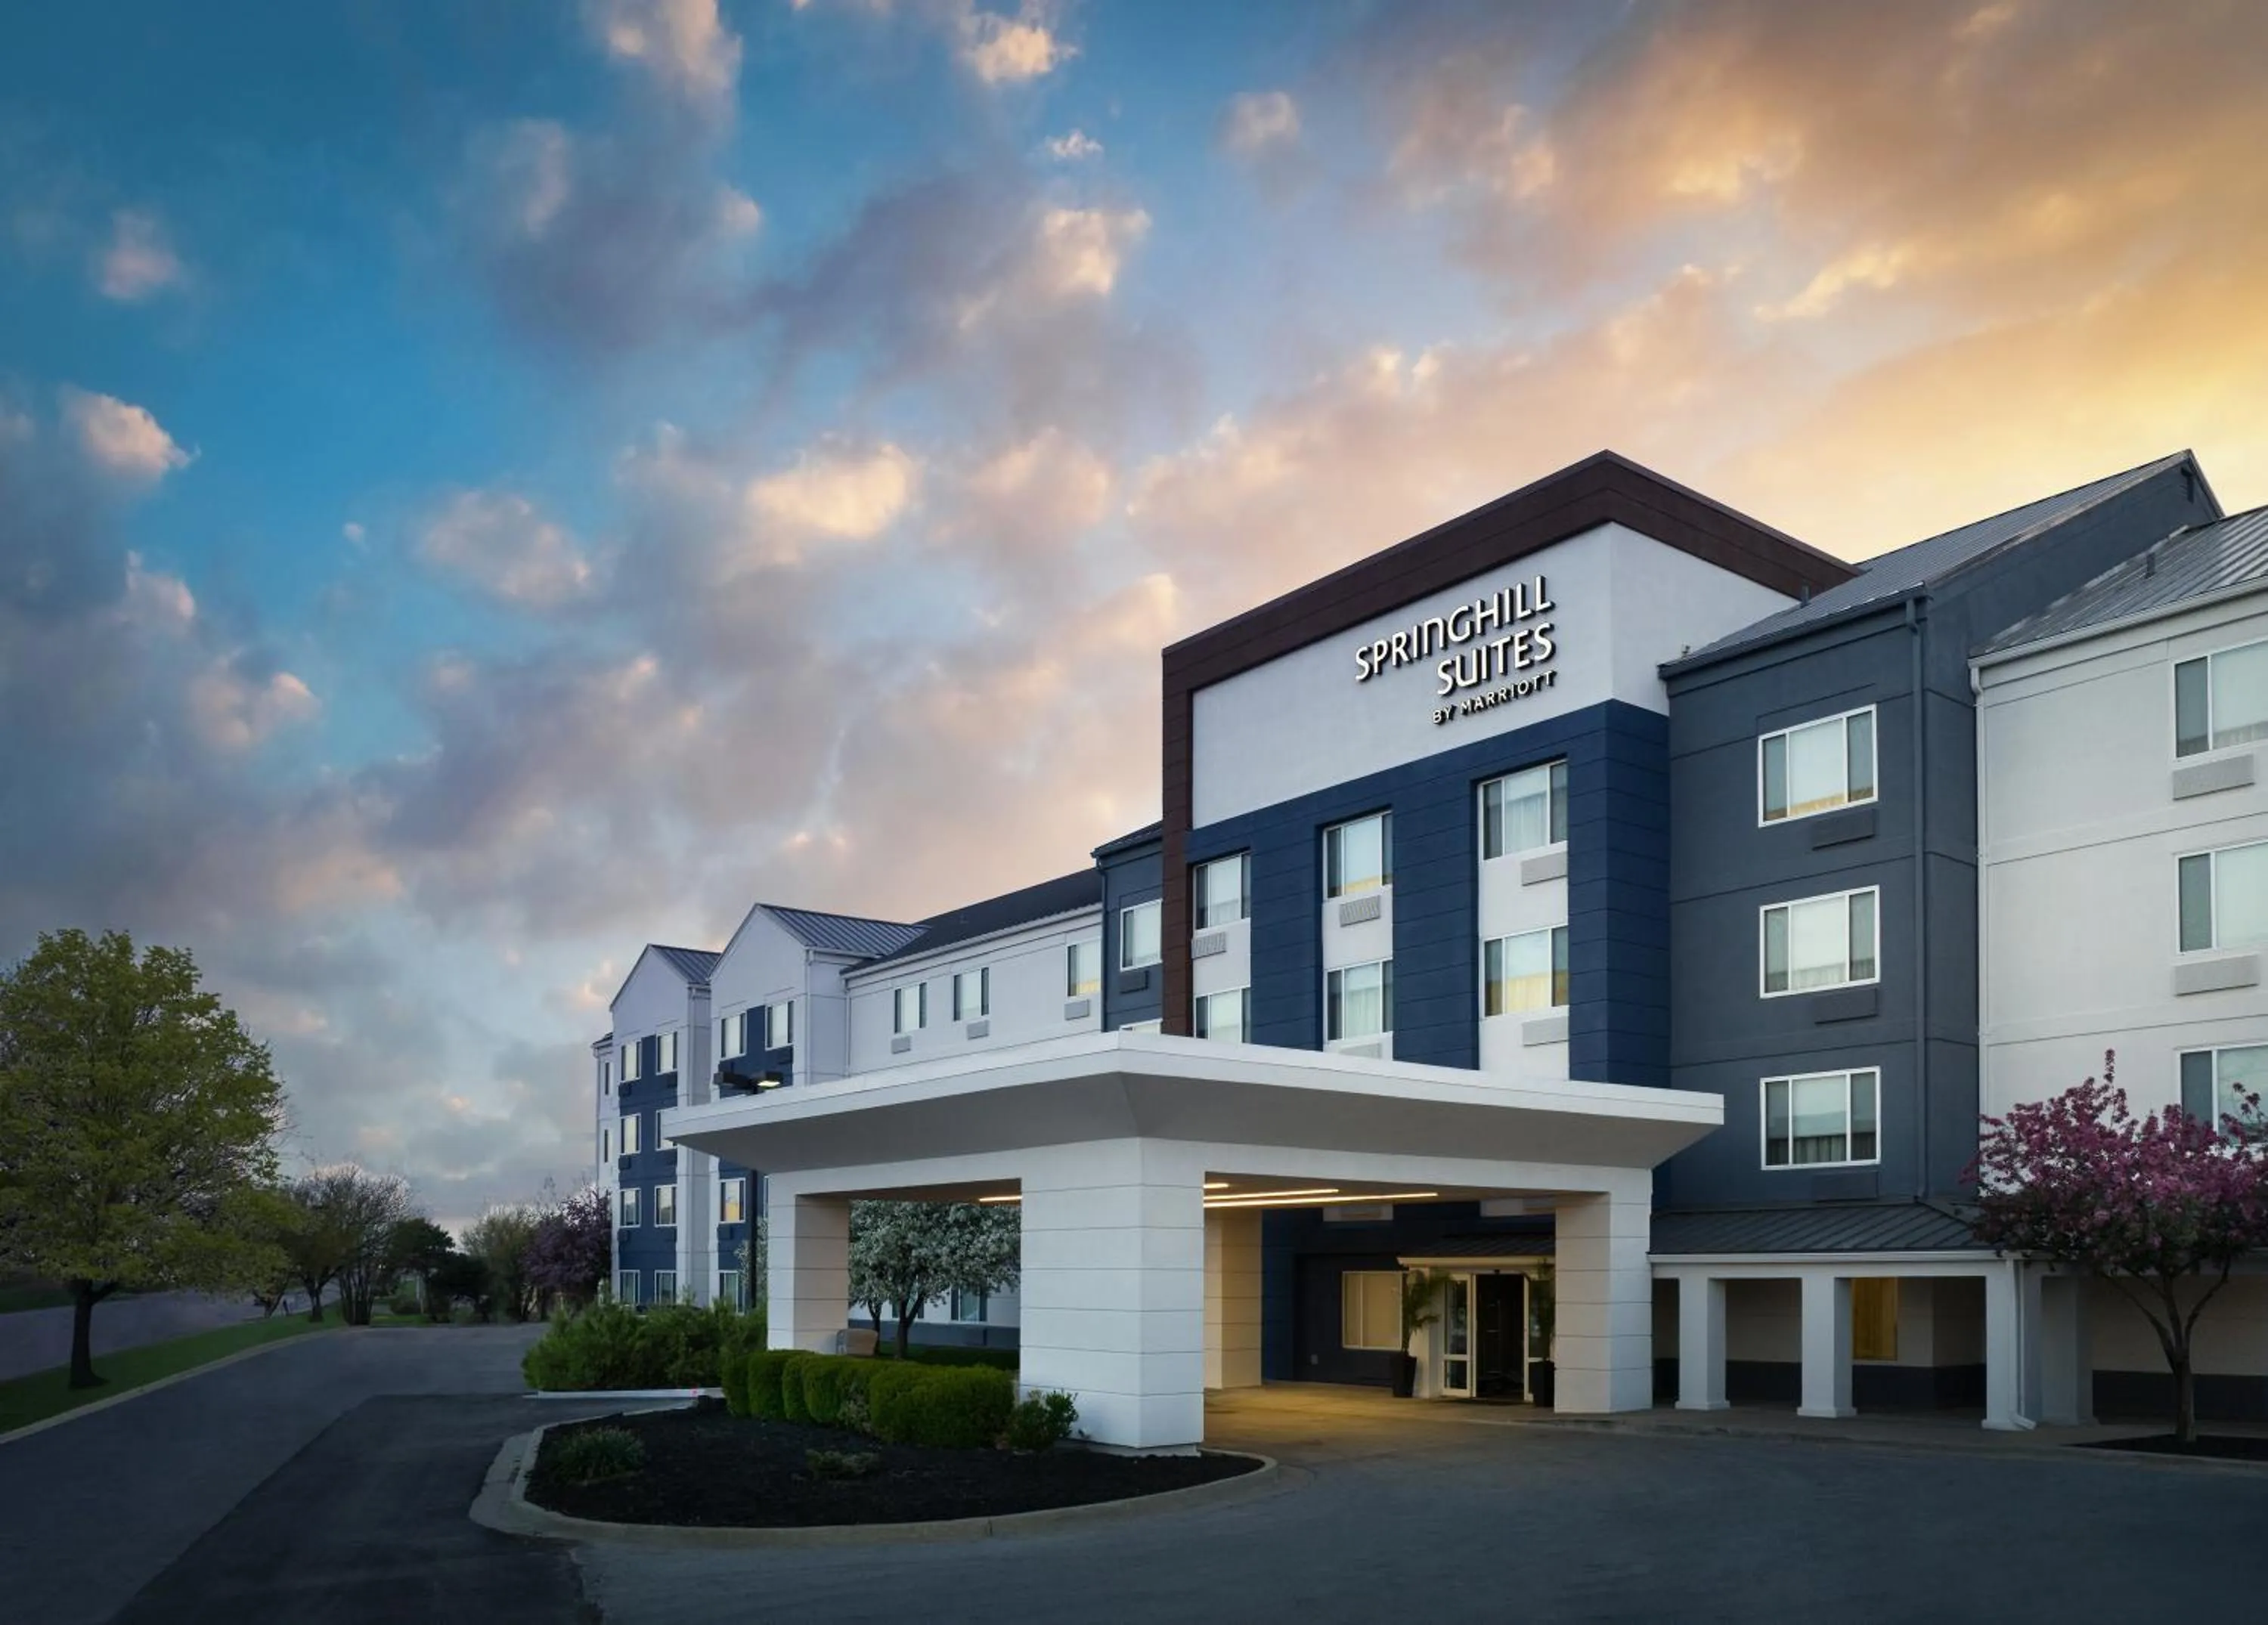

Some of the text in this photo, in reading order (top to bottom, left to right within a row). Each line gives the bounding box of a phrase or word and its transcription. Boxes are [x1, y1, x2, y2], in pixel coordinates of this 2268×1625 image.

[1355, 574, 1555, 681] SPRINGHILL
[1436, 622, 1555, 695] SUITES
[1432, 670, 1557, 725] BY MARRIOTT
